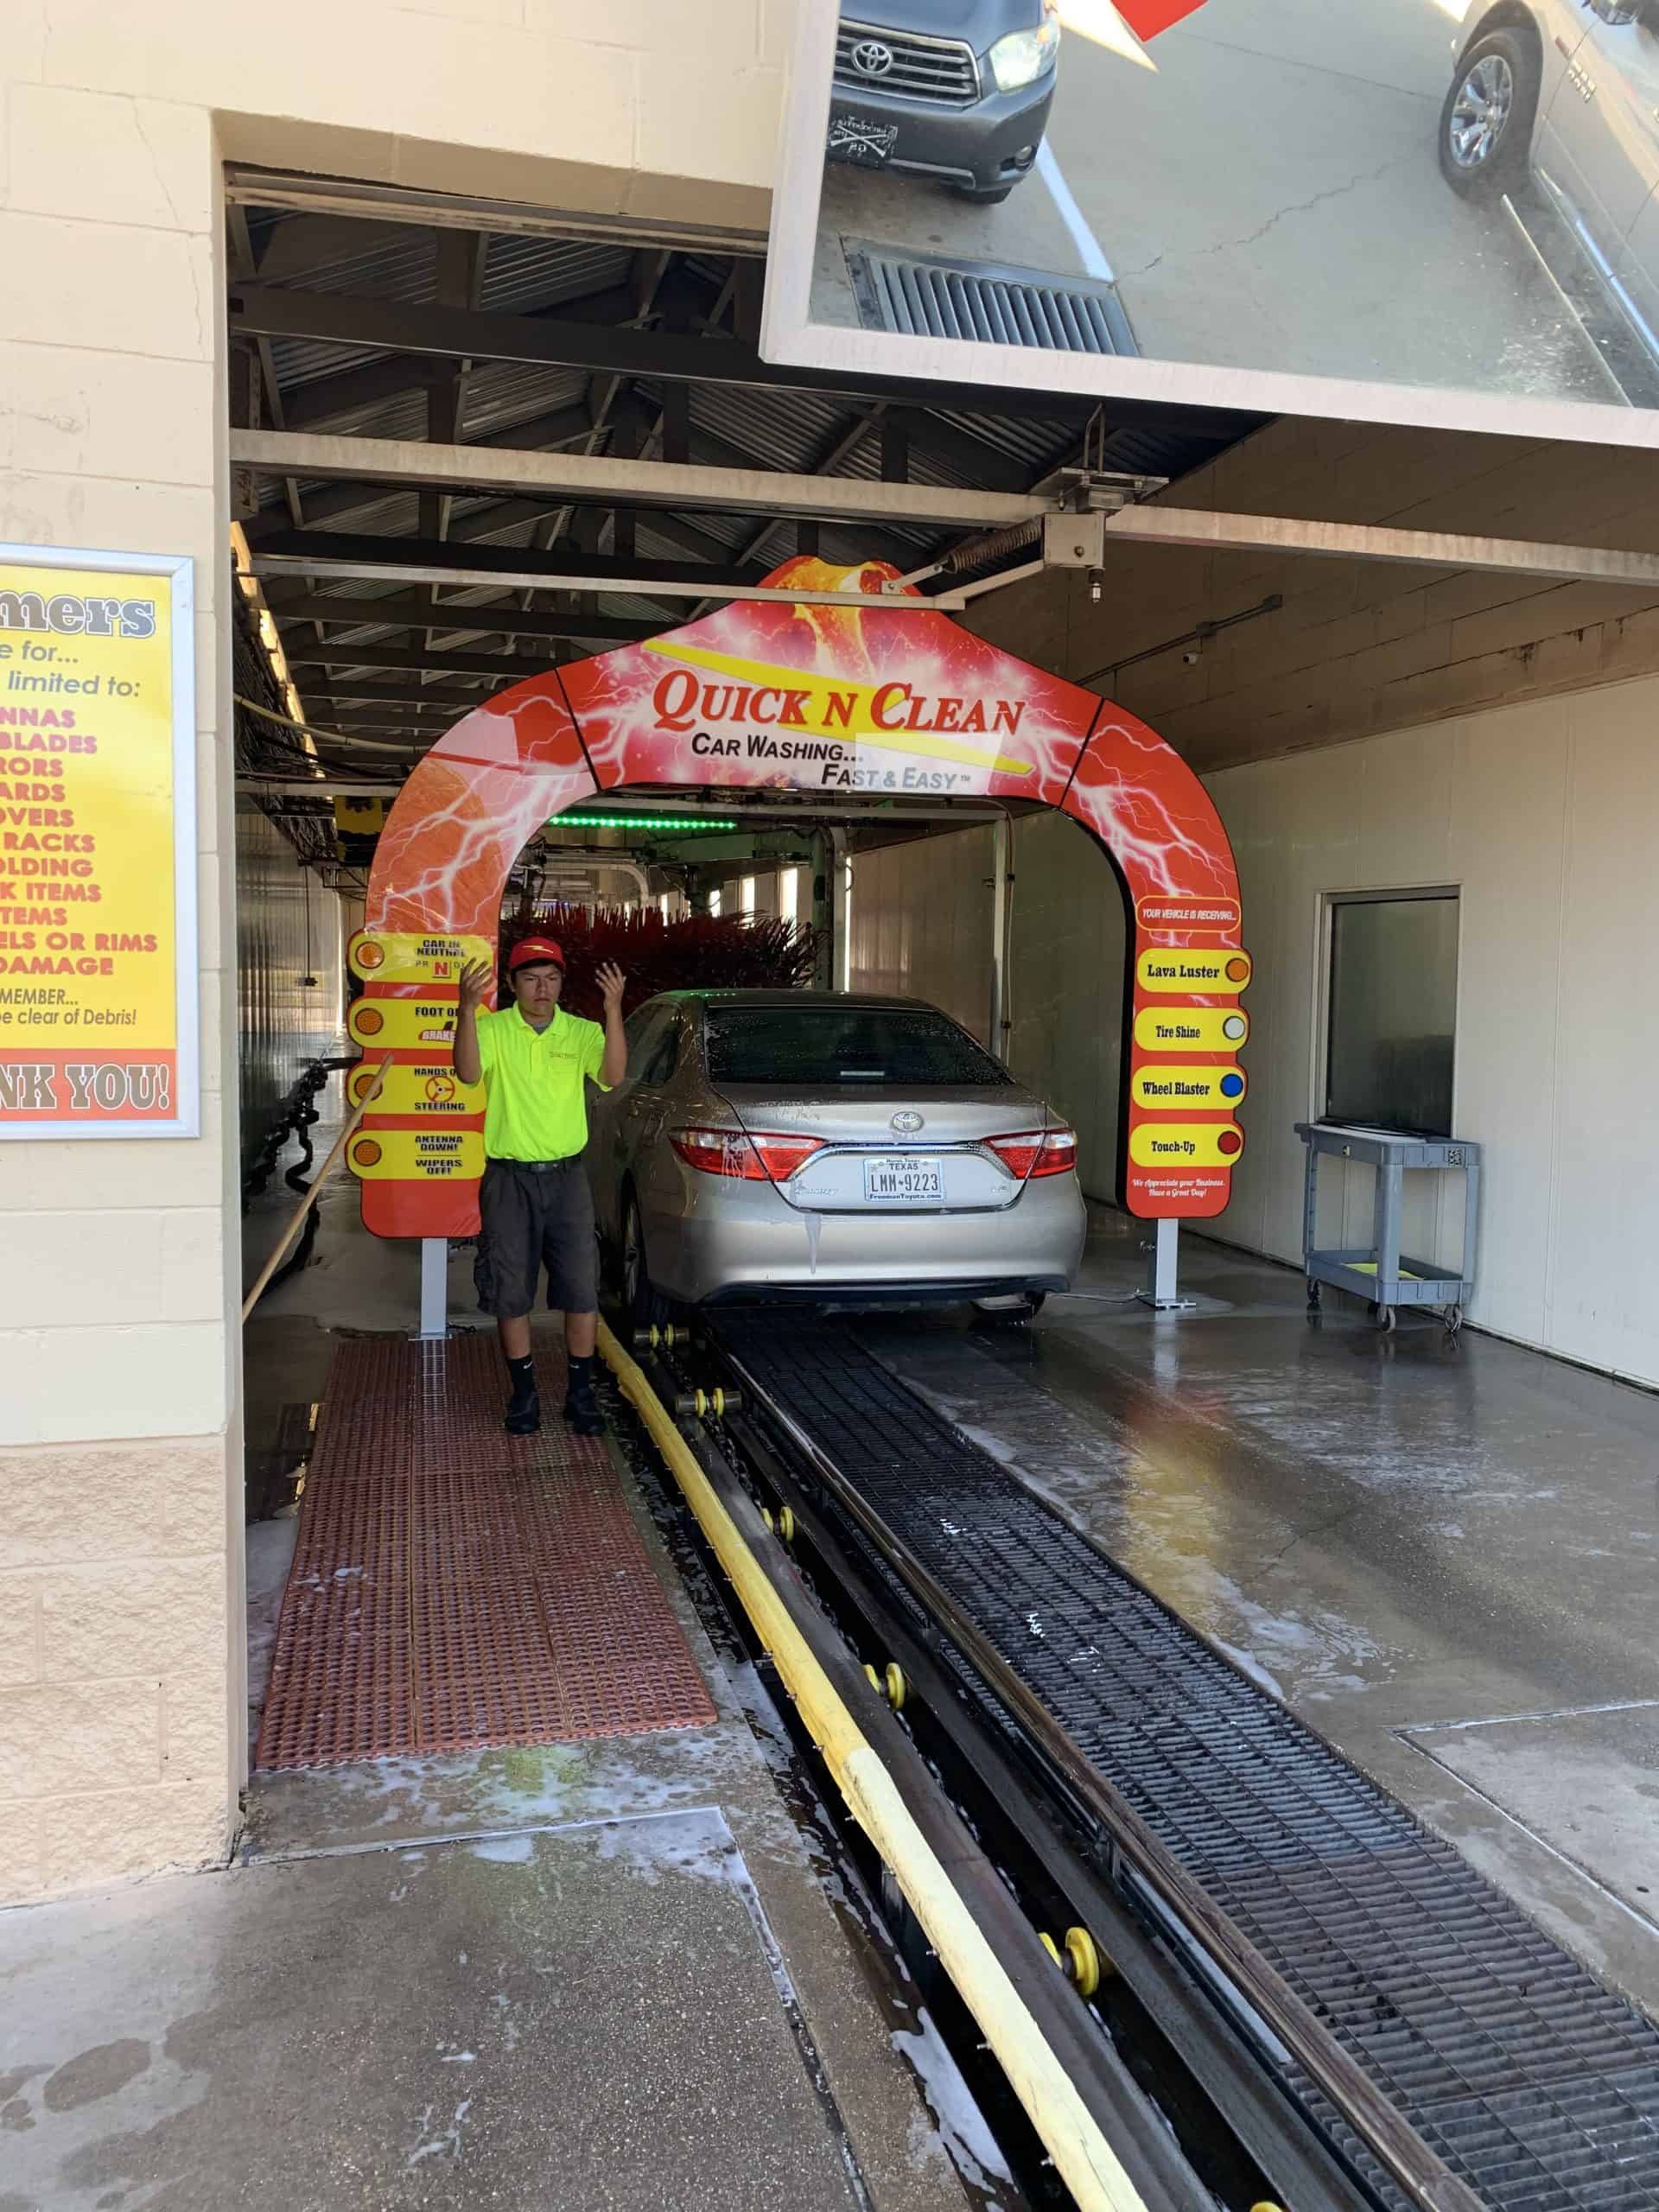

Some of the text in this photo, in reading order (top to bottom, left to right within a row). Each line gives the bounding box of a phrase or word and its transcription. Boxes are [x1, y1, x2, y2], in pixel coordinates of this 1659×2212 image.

[0, 590, 156, 639] mers
[22, 639, 79, 663] for...
[8, 671, 140, 697] limited to:
[653, 670, 1026, 734] QUICK N CLEAN
[0, 706, 76, 728] NNAS
[692, 733, 741, 756] CAR
[821, 764, 879, 786] FAST
[883, 772, 895, 787] &
[3, 832, 95, 853] RACKS
[26, 883, 102, 902] ITEMS
[46, 933, 85, 950] OR
[95, 934, 157, 952] RIMS
[423, 939, 445, 948] CAR
[434, 961, 448, 976] N
[1147, 964, 1219, 978] Lava Luster
[17, 1008, 59, 1025] clear
[63, 1009, 79, 1025] of
[83, 1009, 137, 1026] Debris!
[415, 1007, 444, 1017] FOOT
[1155, 1025, 1200, 1038] Tire Shine
[415, 1068, 448, 1077] HANDS
[65, 1064, 170, 1110] YOU!
[1142, 1082, 1210, 1095] Wheel Blaster
[415, 1102, 465, 1111] STEERING
[421, 1143, 457, 1152] DOWN!
[1152, 1141, 1195, 1154] Touch-Up
[416, 1159, 462, 1167] WIPERS
